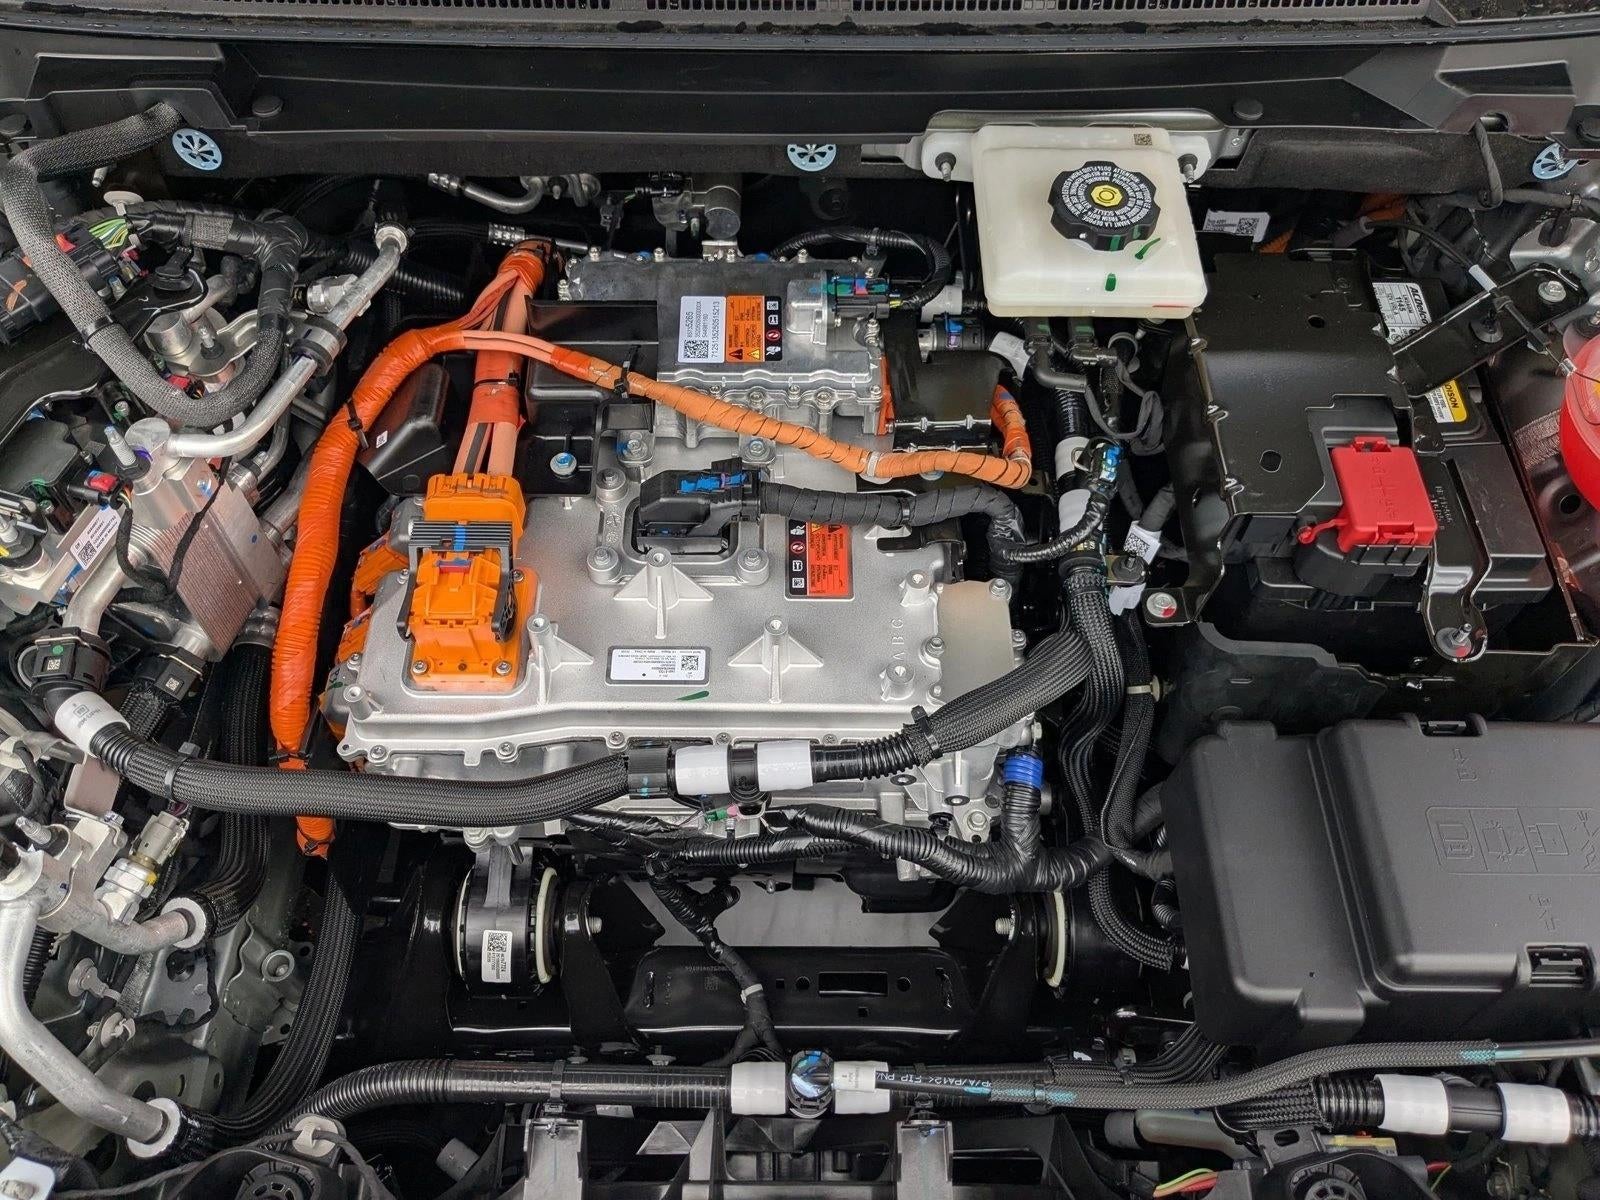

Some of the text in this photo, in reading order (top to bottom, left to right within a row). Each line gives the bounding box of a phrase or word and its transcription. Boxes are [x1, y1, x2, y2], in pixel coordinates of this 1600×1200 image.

[1113, 219, 1131, 228] AVANT
[1409, 286, 1429, 325] ACDelco
[1445, 384, 1459, 409] OISON
